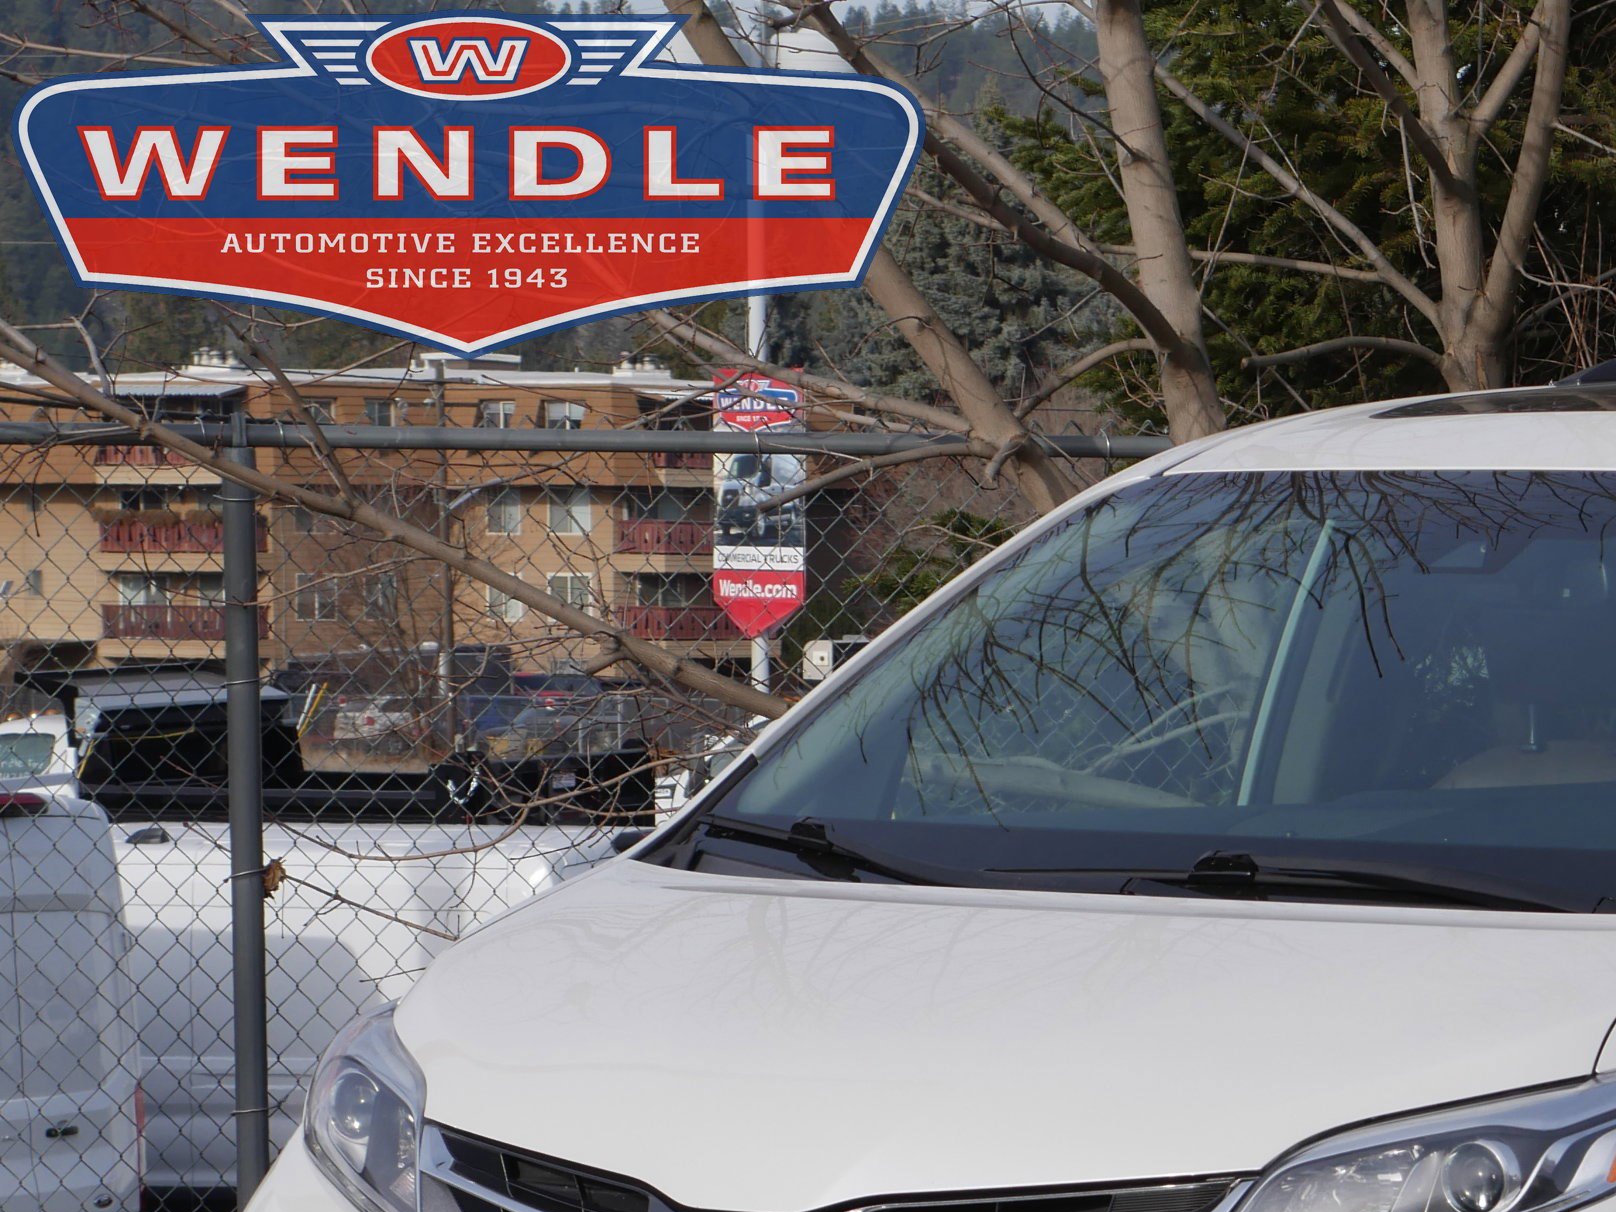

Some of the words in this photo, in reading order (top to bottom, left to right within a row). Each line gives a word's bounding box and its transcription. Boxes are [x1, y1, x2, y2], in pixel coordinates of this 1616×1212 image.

[720, 397, 790, 411] WENDL
[763, 554, 799, 564] TRUCKS
[719, 579, 797, 599] Wendle.com
